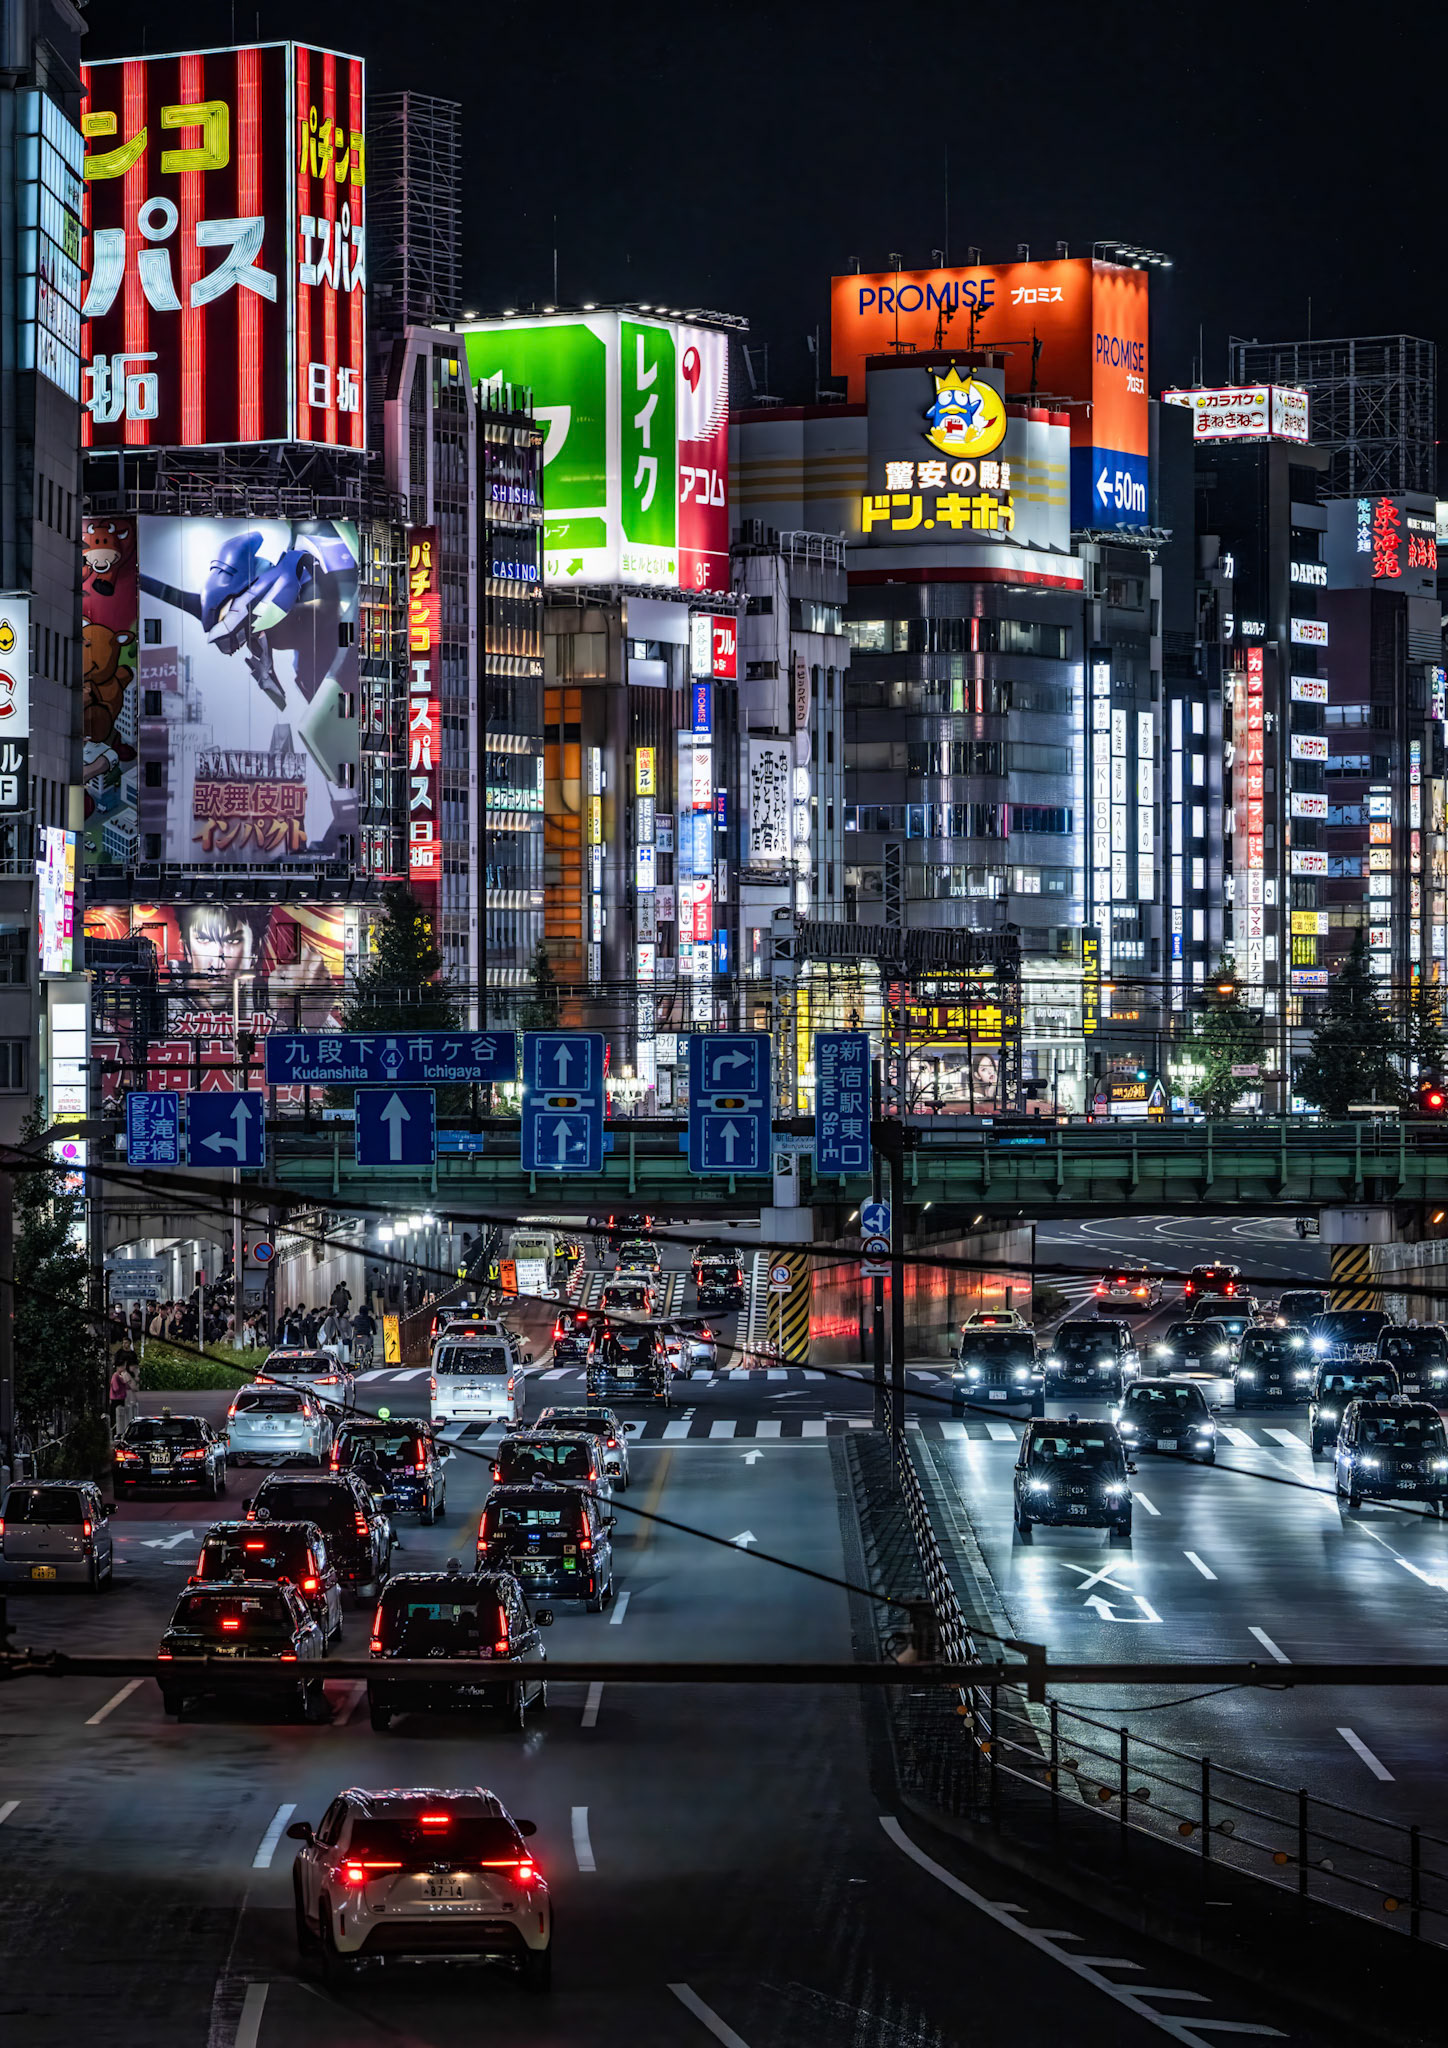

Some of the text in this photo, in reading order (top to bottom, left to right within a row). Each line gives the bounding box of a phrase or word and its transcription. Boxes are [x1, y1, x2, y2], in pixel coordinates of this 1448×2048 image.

[299, 105, 366, 187] パチンコ
[300, 201, 366, 295] エスパス
[859, 278, 996, 316] PROMISE
[1010, 286, 1064, 306] プロミス
[1095, 332, 1145, 374] PROMISE
[308, 361, 360, 413] 日拓
[1125, 373, 1145, 395] プロミス
[1206, 393, 1255, 408] カラオケ
[633, 333, 659, 513] レイク
[1197, 411, 1264, 432] まねきねこ
[680, 465, 726, 508] アコム
[885, 459, 1011, 491] 驚安の殿堂
[492, 484, 536, 505] SHISHA
[1114, 471, 1146, 514] 50m
[1371, 496, 1403, 578] 東海苑
[492, 560, 537, 581] CASINO
[621, 552, 667, 575] 当ビルとなり
[695, 562, 711, 587] 3F
[1290, 562, 1328, 587] DARTS
[140, 663, 178, 679] エスパス
[409, 541, 433, 867] パチンコ エスパス 日拓
[697, 687, 706, 723] PROMISE
[1247, 657, 1263, 815] カラオケパセラ
[195, 751, 308, 779] EVANGELION
[192, 783, 308, 817] 歌舞伎町
[1096, 767, 1107, 864] KIBORI
[192, 817, 308, 851] インパクト
[696, 903, 707, 931] アコム
[1173, 910, 1182, 931] ZEST
[1250, 906, 1262, 936] ママ会
[173, 1011, 274, 1038] メガホール
[285, 1039, 376, 1065] 九段下
[387, 1053, 396, 1065] 4
[678, 1041, 689, 1056] 3F
[292, 1066, 369, 1081] Kudanshita
[423, 1064, 482, 1081] Ichigaya
[821, 1043, 839, 1107] Shinjuku
[839, 1039, 864, 1165] 新宿駅東口
[131, 1095, 150, 1163] Otakibashi Brdg.
[149, 1096, 175, 1161] 小滝橋
[430, 1885, 462, 1897] 87-14
